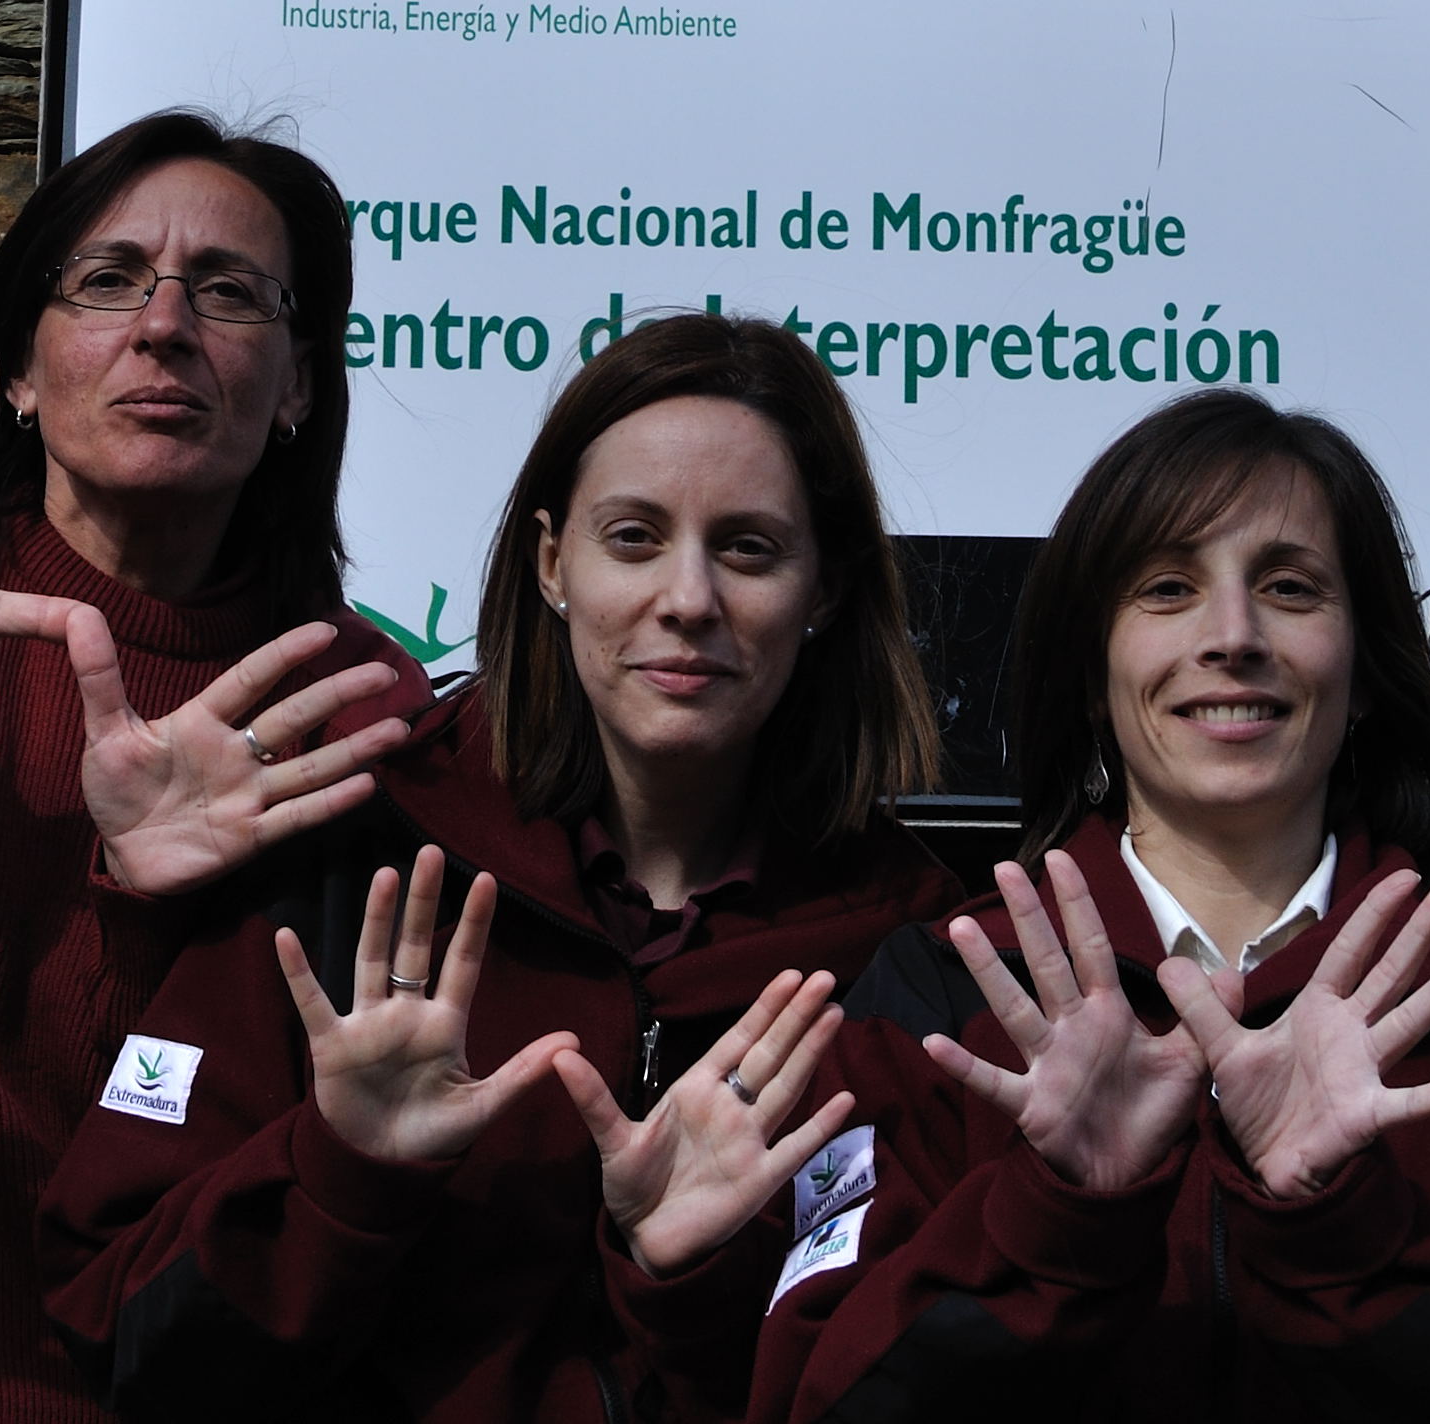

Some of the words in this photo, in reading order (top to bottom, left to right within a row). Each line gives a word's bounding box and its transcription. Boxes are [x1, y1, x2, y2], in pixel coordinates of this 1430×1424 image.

[405, 0, 497, 41] Energía
[505, 12, 520, 42] y
[529, 3, 608, 35] Medio
[613, 5, 737, 38] Ambiente
[346, 199, 478, 262] rque
[500, 184, 758, 249] Nacional
[779, 190, 849, 251] de
[872, 191, 1186, 275] Monfragüe
[345, 298, 550, 373] entro
[108, 1086, 178, 1113] Extremadura
